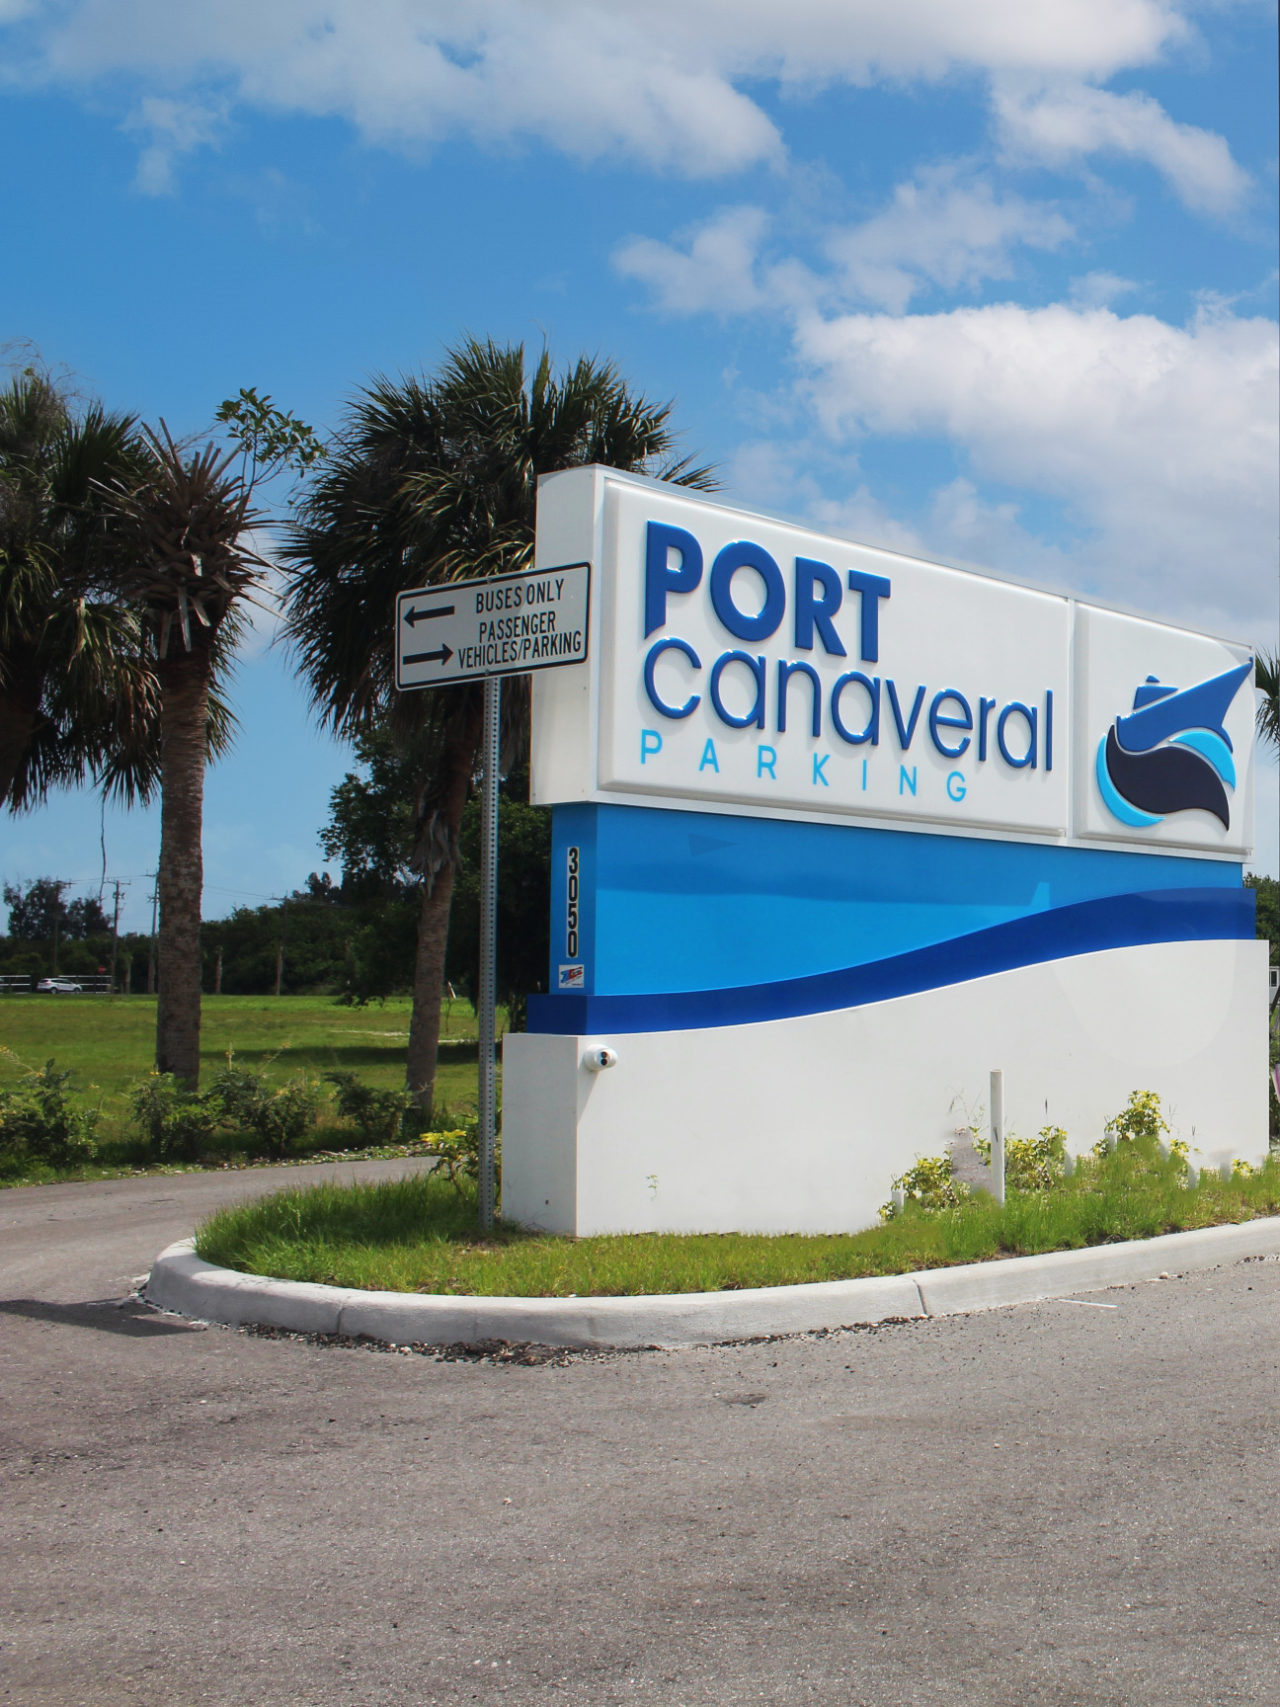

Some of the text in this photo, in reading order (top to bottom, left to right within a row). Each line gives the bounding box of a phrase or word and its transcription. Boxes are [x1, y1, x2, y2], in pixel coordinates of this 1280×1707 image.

[477, 579, 564, 613] BUSES ONLY
[645, 520, 891, 663] PORT
[458, 631, 581, 668] VEHICLES/PARKING
[479, 611, 555, 643] PASSENGER
[641, 730, 967, 802] PARKING
[567, 847, 578, 957] 3050
